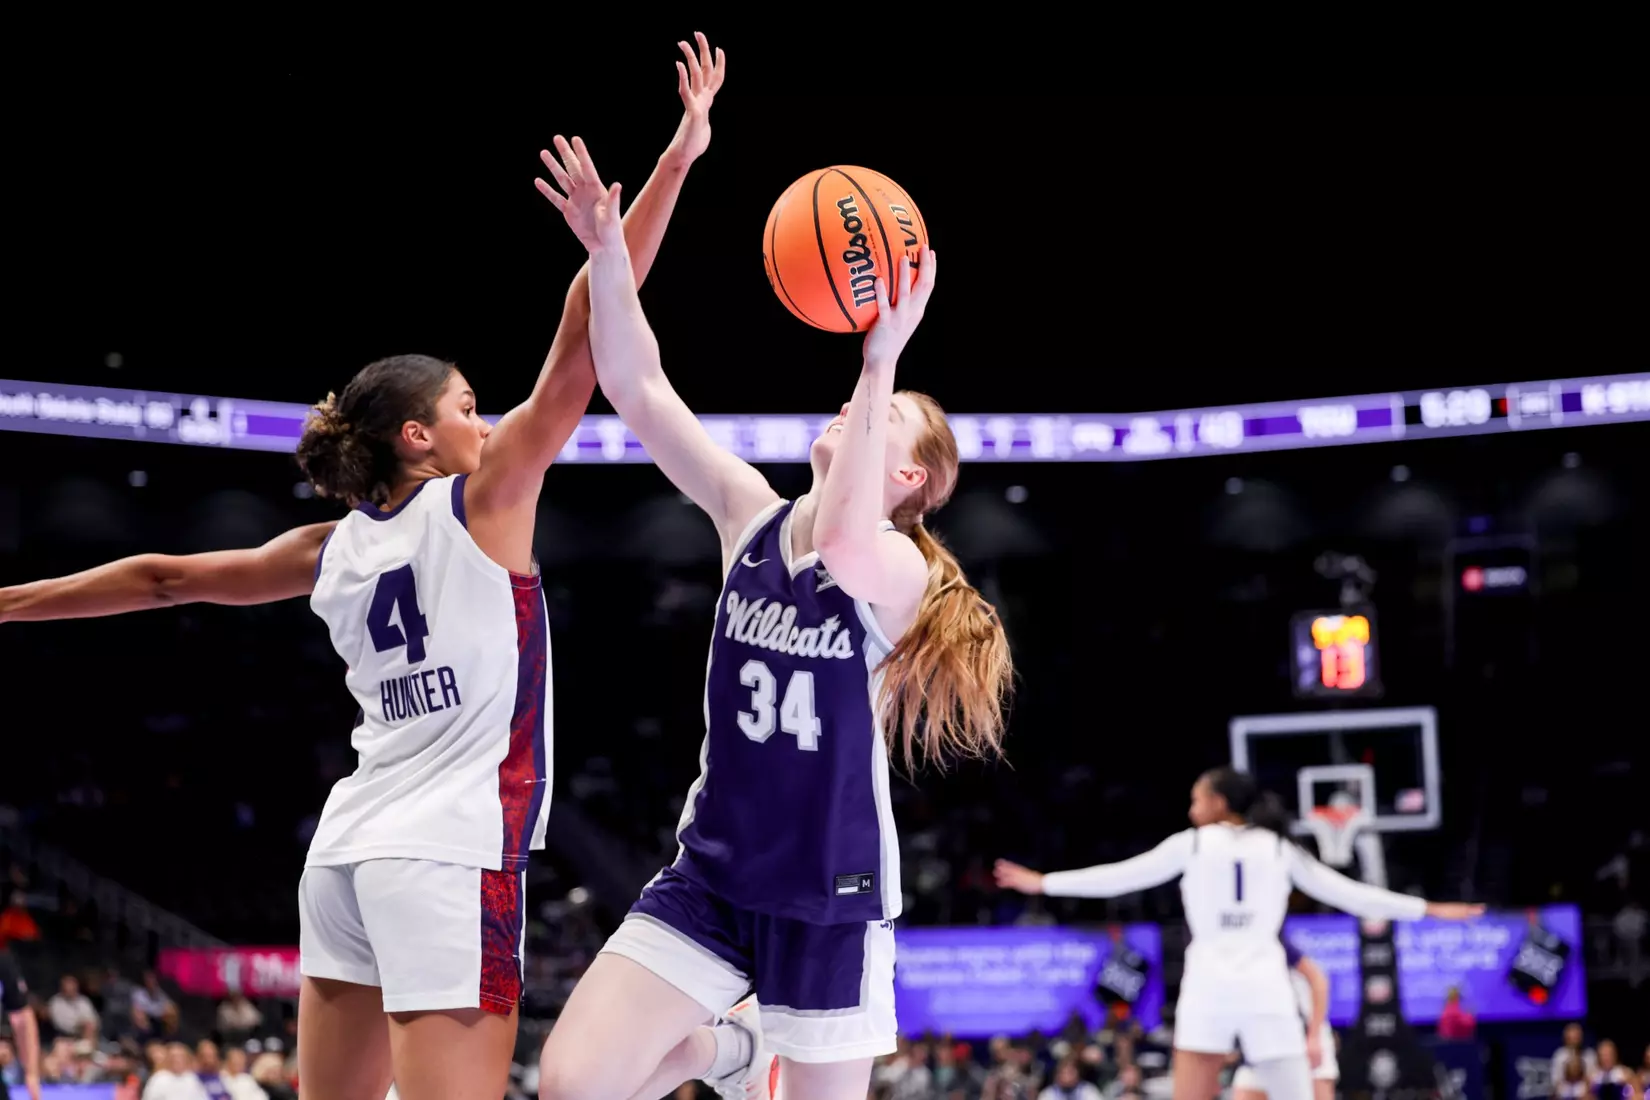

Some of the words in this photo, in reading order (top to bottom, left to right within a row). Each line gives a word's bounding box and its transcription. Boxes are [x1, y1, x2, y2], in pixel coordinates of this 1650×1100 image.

[836, 195, 878, 308] Wilson
[888, 204, 920, 269] EVO
[366, 563, 430, 665] 4
[725, 590, 854, 660] Wildcats
[380, 665, 462, 722] HUNTER
[736, 659, 822, 752] 34
[862, 879, 871, 888] M
[1233, 859, 1244, 904] 1
